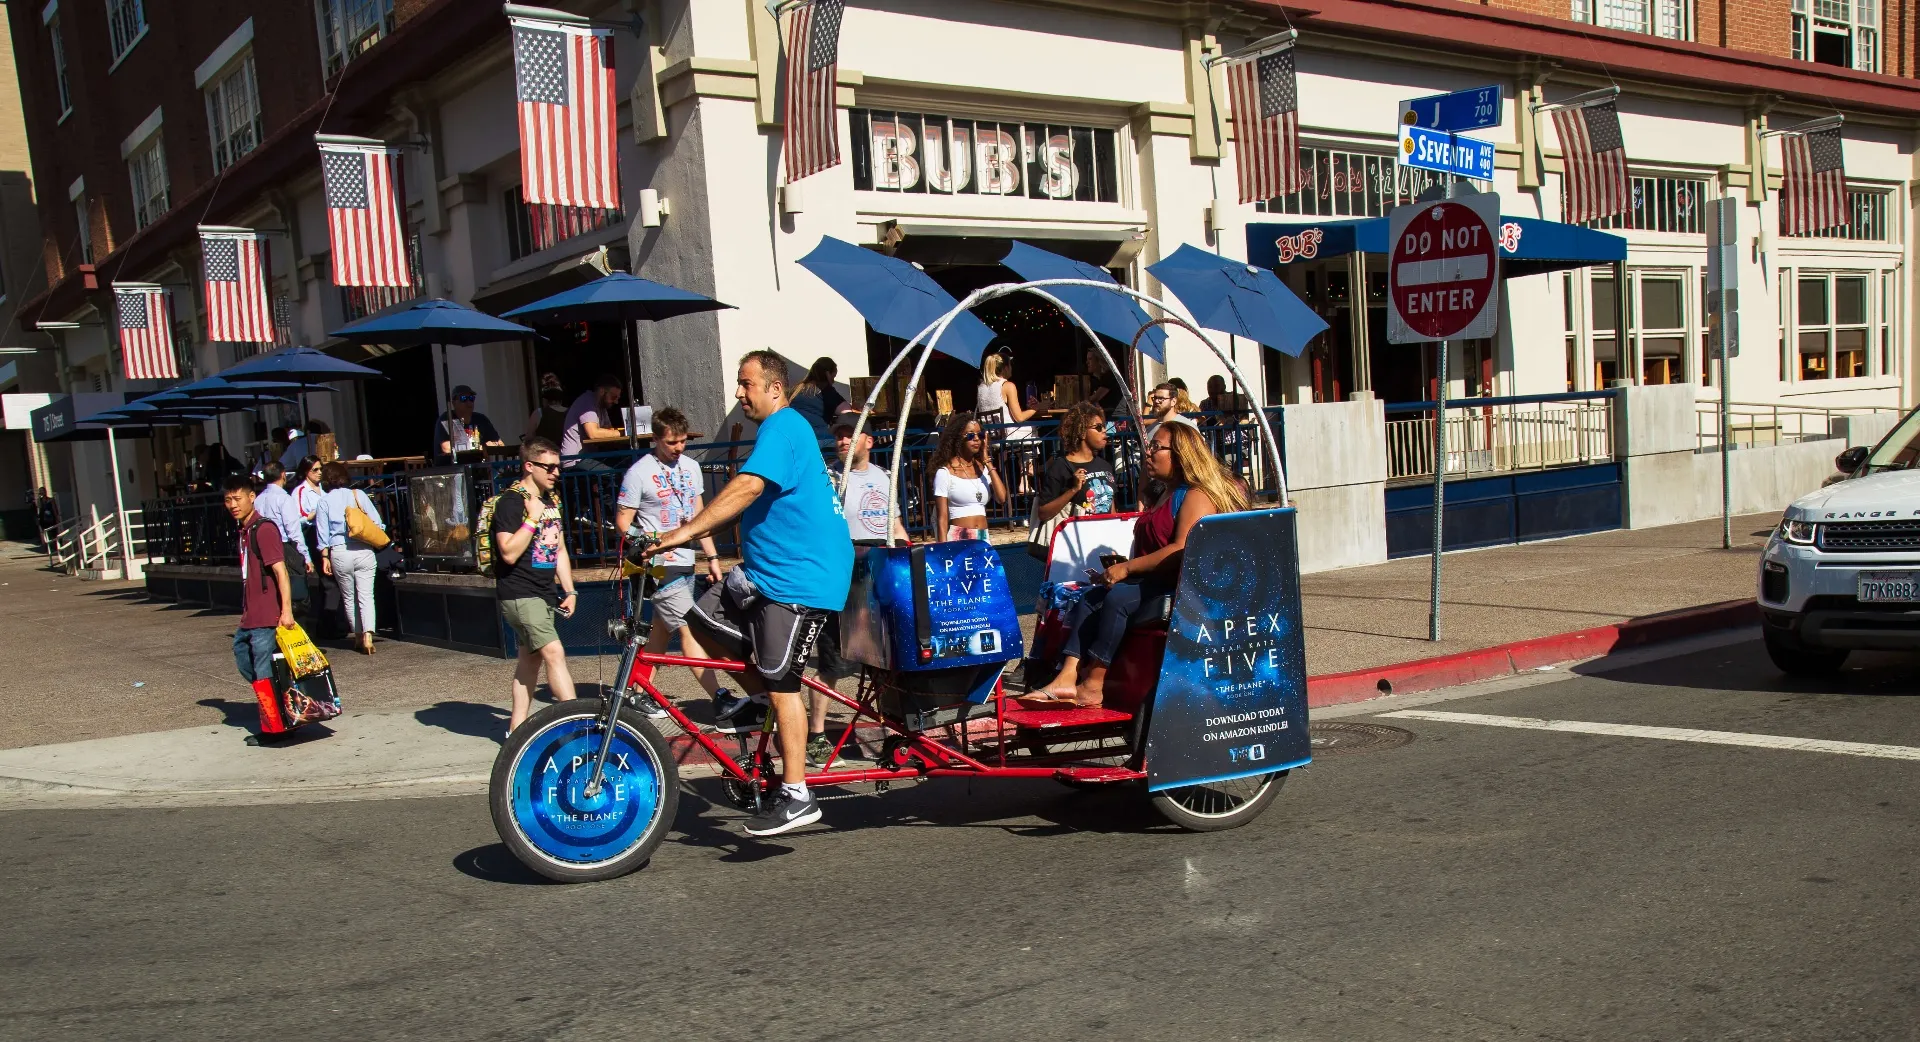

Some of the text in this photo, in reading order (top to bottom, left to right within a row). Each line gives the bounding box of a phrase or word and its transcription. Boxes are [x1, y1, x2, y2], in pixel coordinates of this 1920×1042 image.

[1479, 91, 1490, 103] ST
[1431, 102, 1440, 128] J
[1474, 104, 1493, 118] 700
[872, 121, 1080, 198] BUB'S
[1418, 134, 1492, 170] SEVENTH AVE
[1405, 225, 1482, 255] DO NOT
[1407, 288, 1475, 314] ENTER
[1825, 510, 1896, 519] RANGE
[926, 555, 995, 575] APEX
[927, 578, 992, 599] FIVE
[1862, 582, 1919, 600] 7PKR882
[1196, 612, 1281, 644] APEX
[1248, 639, 1275, 649] KATZ
[1204, 648, 1279, 678] FIVE
[1206, 706, 1285, 727] DOWNLOAD TODAY
[1203, 720, 1288, 742] ON AMAZON KINDLE!
[542, 752, 630, 774] APX
